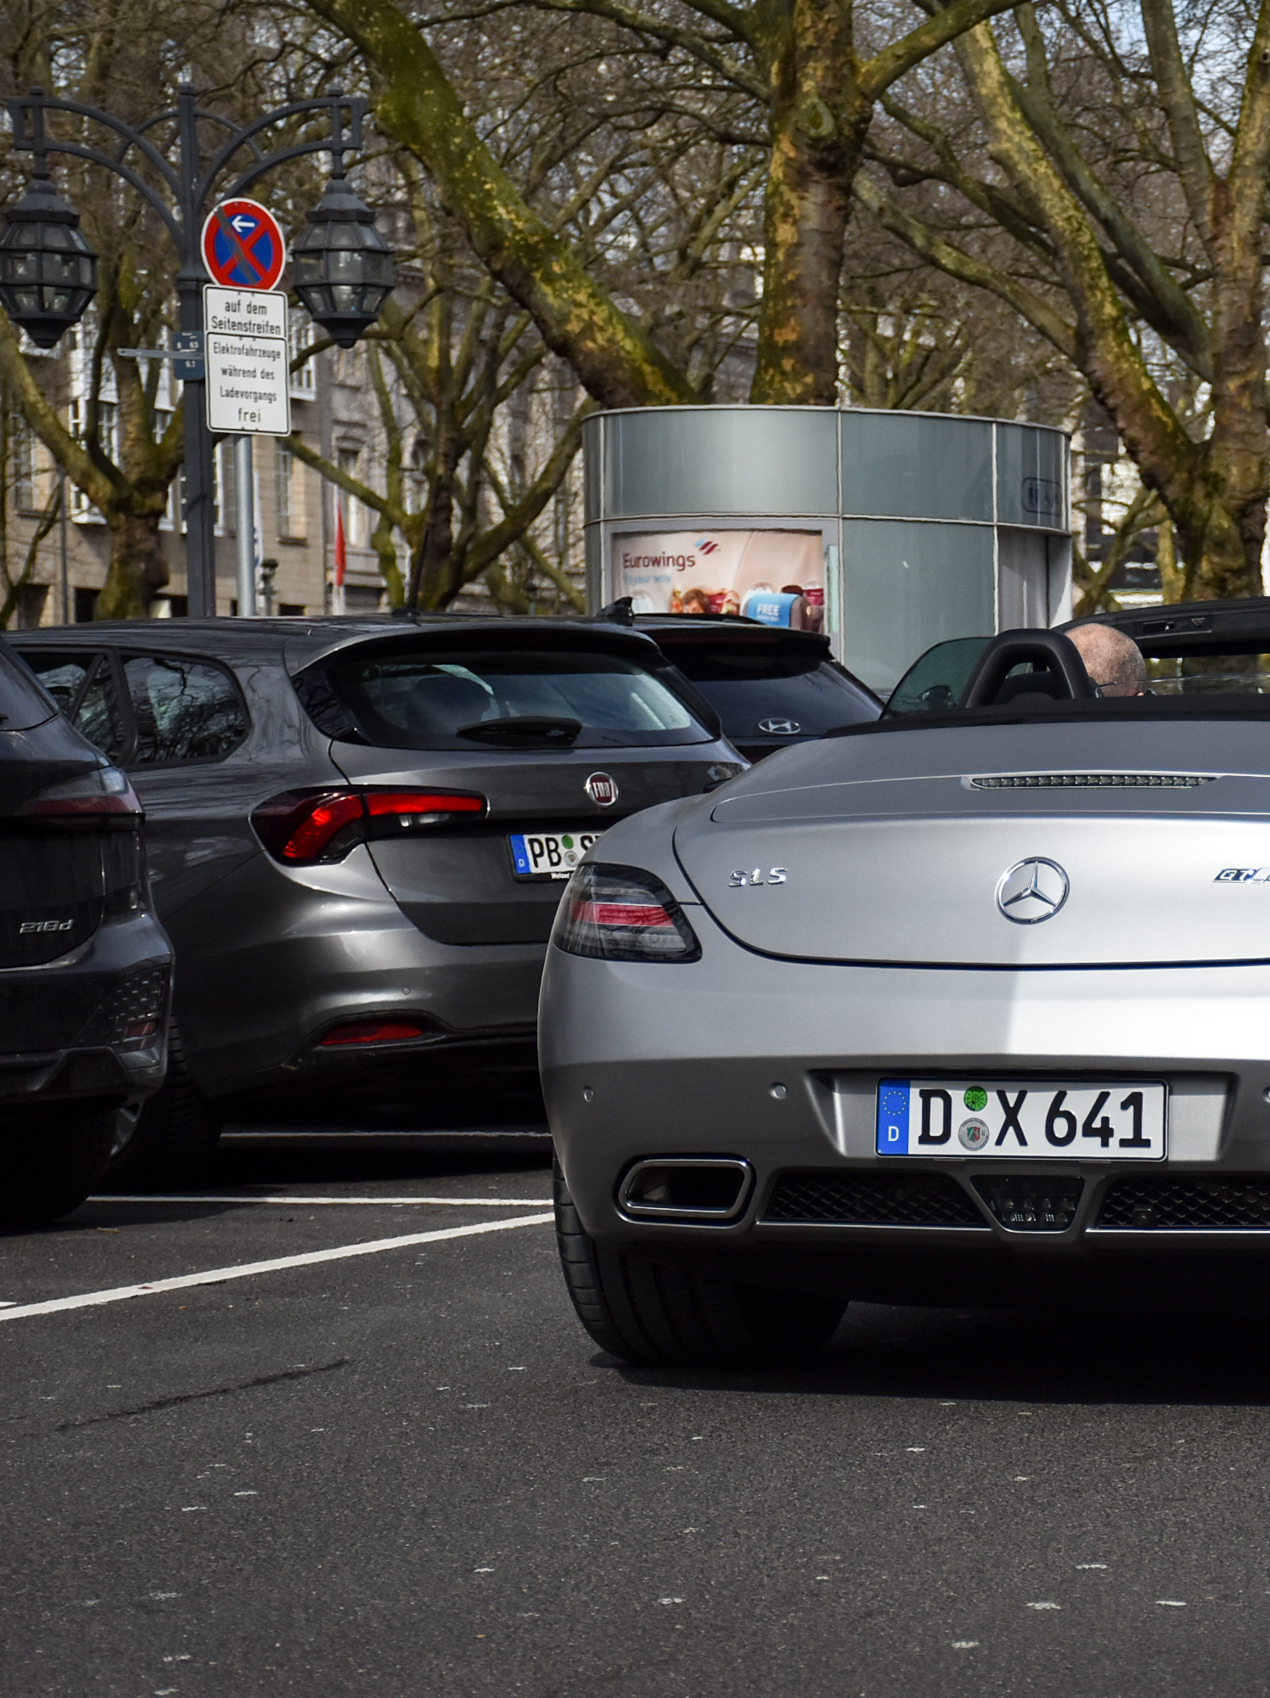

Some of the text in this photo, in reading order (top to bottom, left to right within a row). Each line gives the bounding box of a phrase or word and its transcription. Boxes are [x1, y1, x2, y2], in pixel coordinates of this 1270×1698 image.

[225, 300, 267, 316] auf dem
[211, 316, 281, 335] Seitenstreifen
[213, 342, 282, 361] Elektrofahrzeuge
[220, 365, 275, 380] während des
[219, 385, 277, 404] Ladevorgangs
[238, 408, 261, 423] frei
[622, 551, 696, 572] Eurowings
[527, 837, 562, 869] PB
[728, 867, 788, 887] SLS
[19, 919, 74, 934] 218d
[918, 1088, 953, 1145] D
[994, 1090, 1029, 1146] X
[1045, 1090, 1152, 1148] 641
[888, 1126, 900, 1142] D
